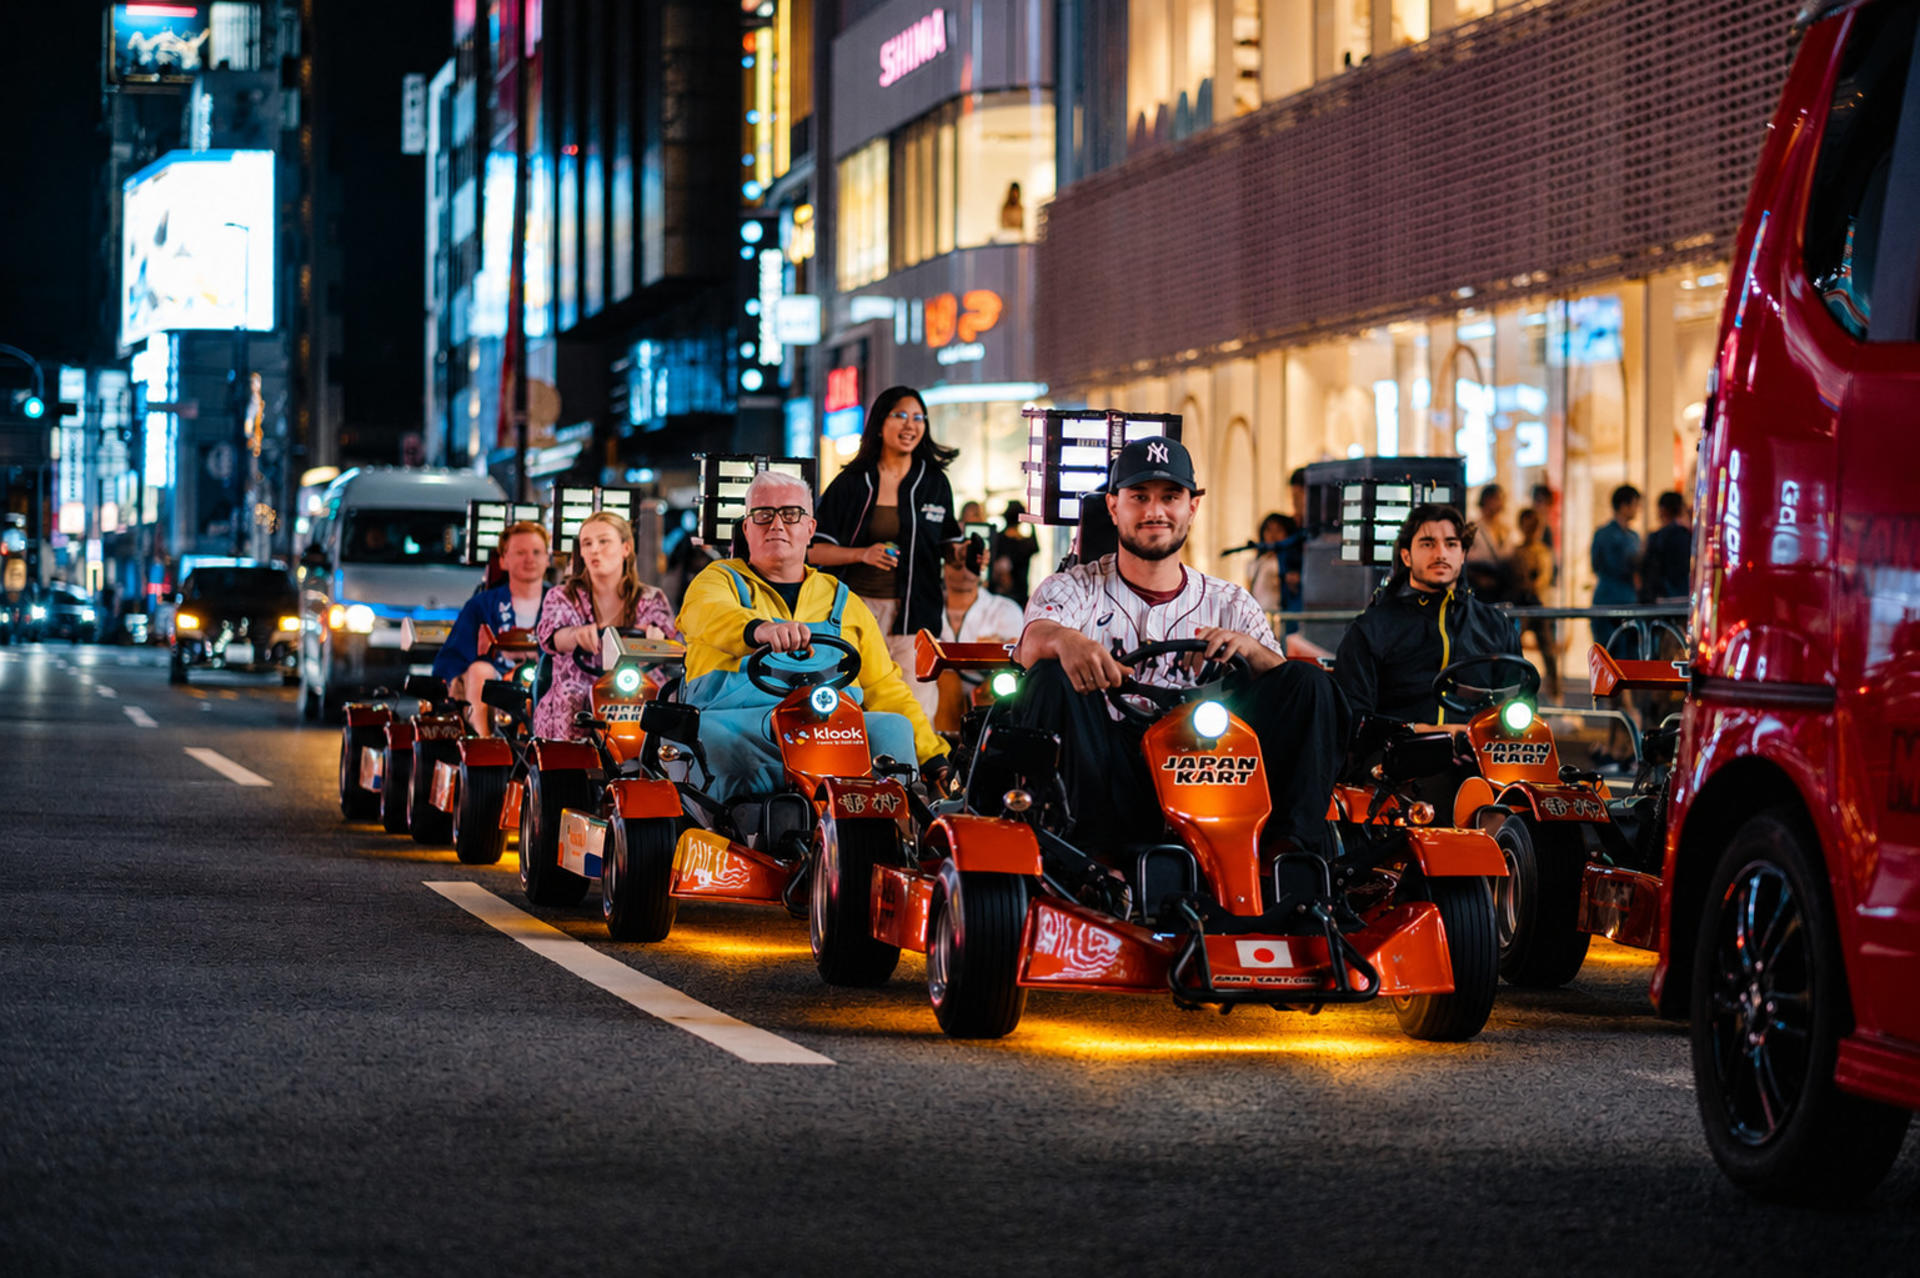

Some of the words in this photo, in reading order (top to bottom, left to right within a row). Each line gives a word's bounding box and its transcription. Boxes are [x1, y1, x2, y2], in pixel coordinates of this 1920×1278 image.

[1146, 442, 1169, 464] NY
[813, 727, 863, 740] klook
[1481, 742, 1551, 754] JAPAN
[1162, 755, 1259, 771] JAPAN
[1491, 753, 1548, 765] KART
[1174, 769, 1254, 785] KART
